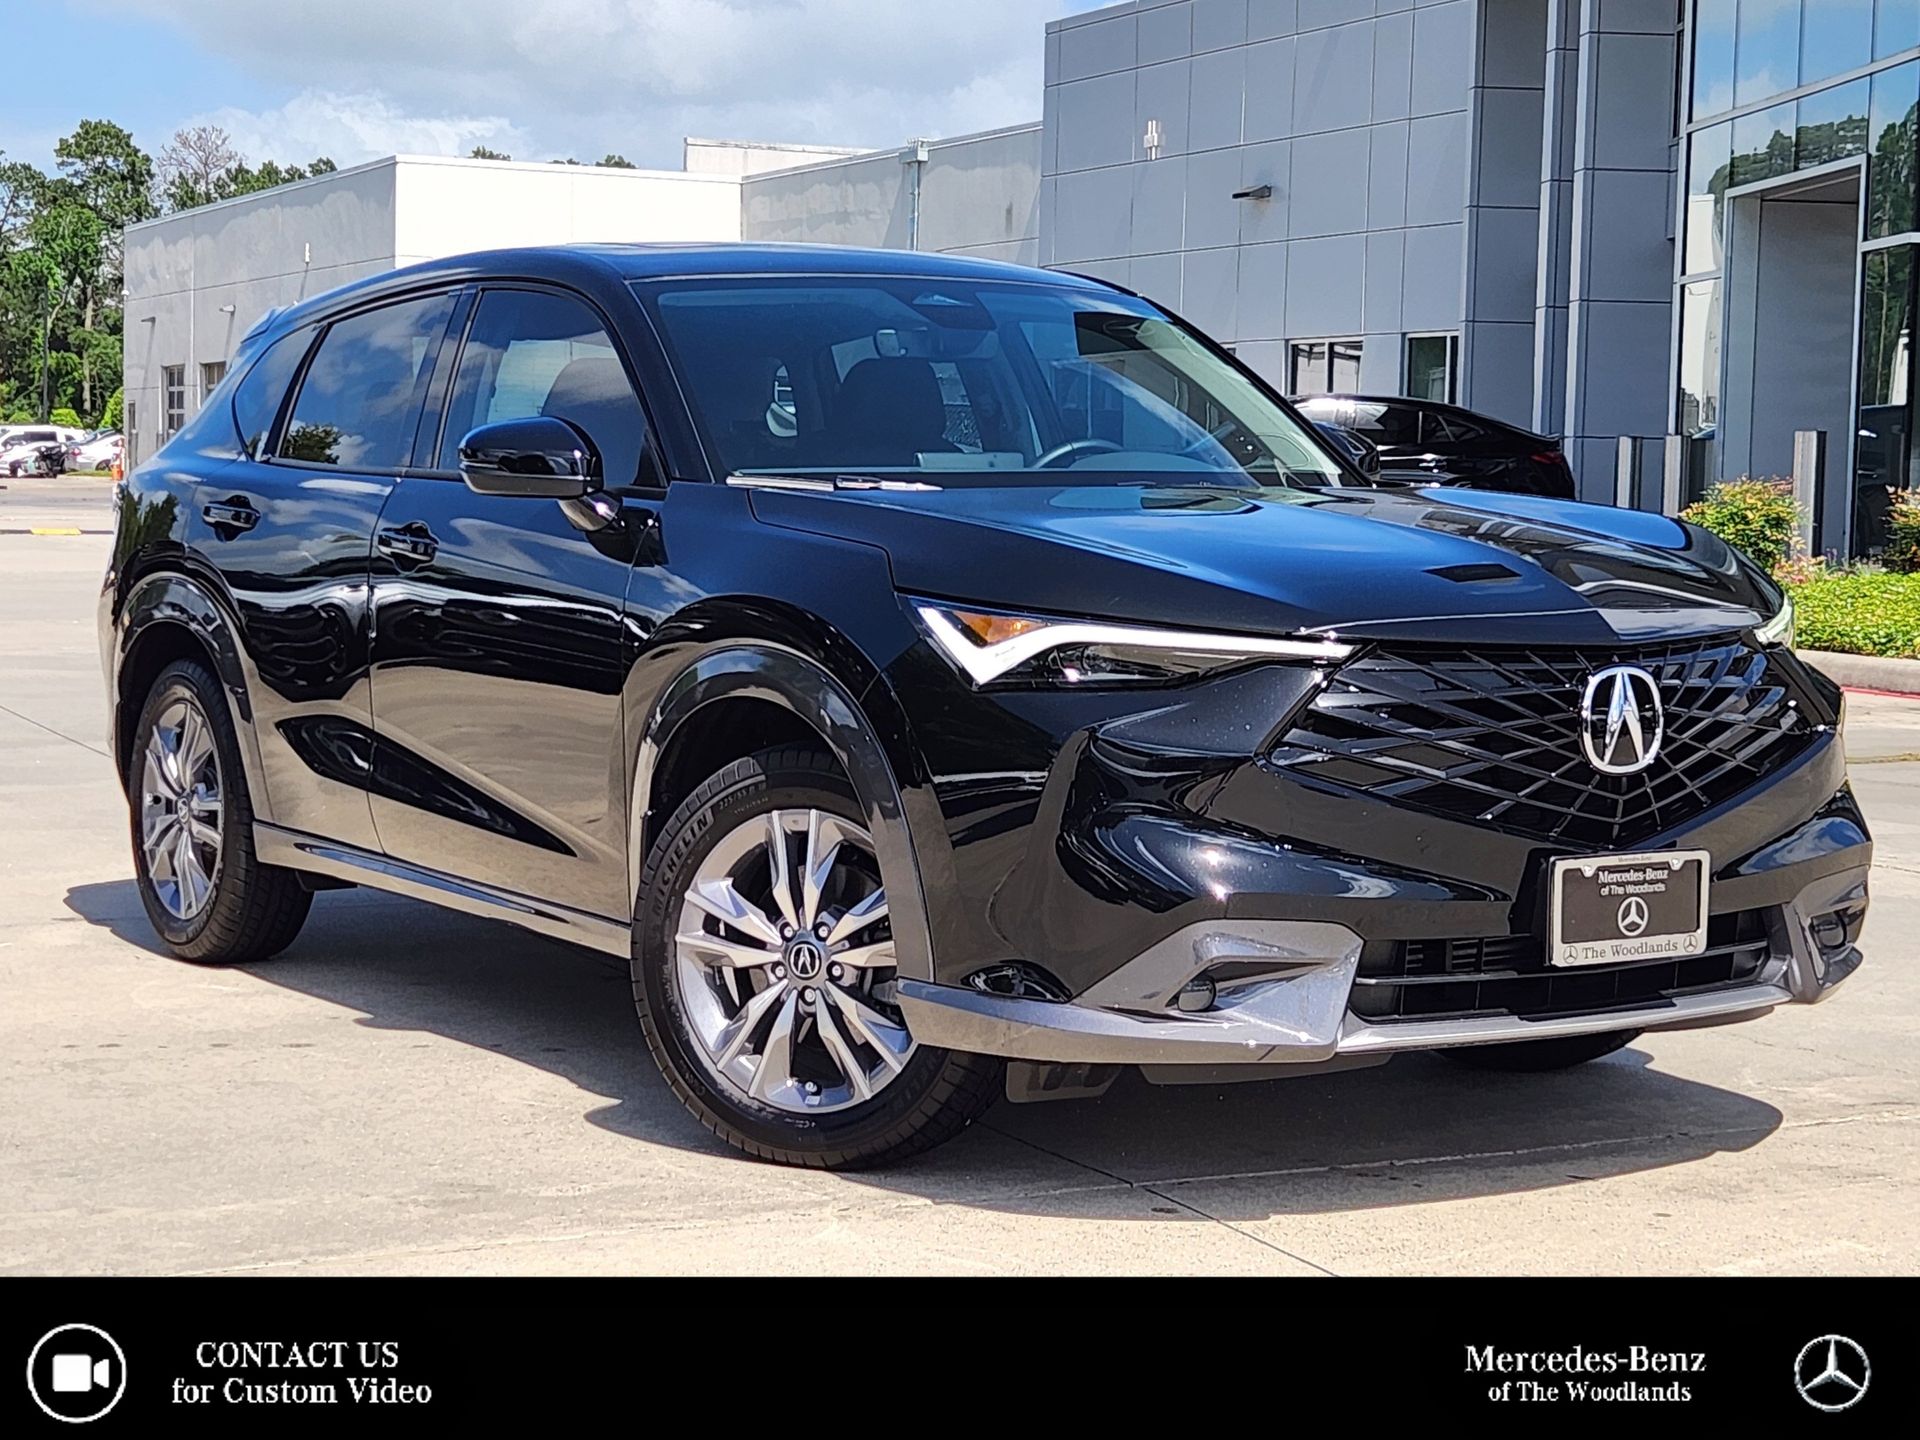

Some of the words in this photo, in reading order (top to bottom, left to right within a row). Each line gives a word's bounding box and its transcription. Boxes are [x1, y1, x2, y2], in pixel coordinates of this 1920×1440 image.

[652, 814, 708, 916] MICHELIN
[1598, 868, 1669, 884] Mercedes-Benz
[1600, 884, 1610, 896] of
[1610, 883, 1625, 896] The
[1625, 882, 1666, 895] Woodlands
[1582, 946, 1607, 960] The
[1610, 939, 1678, 958] Woodlands
